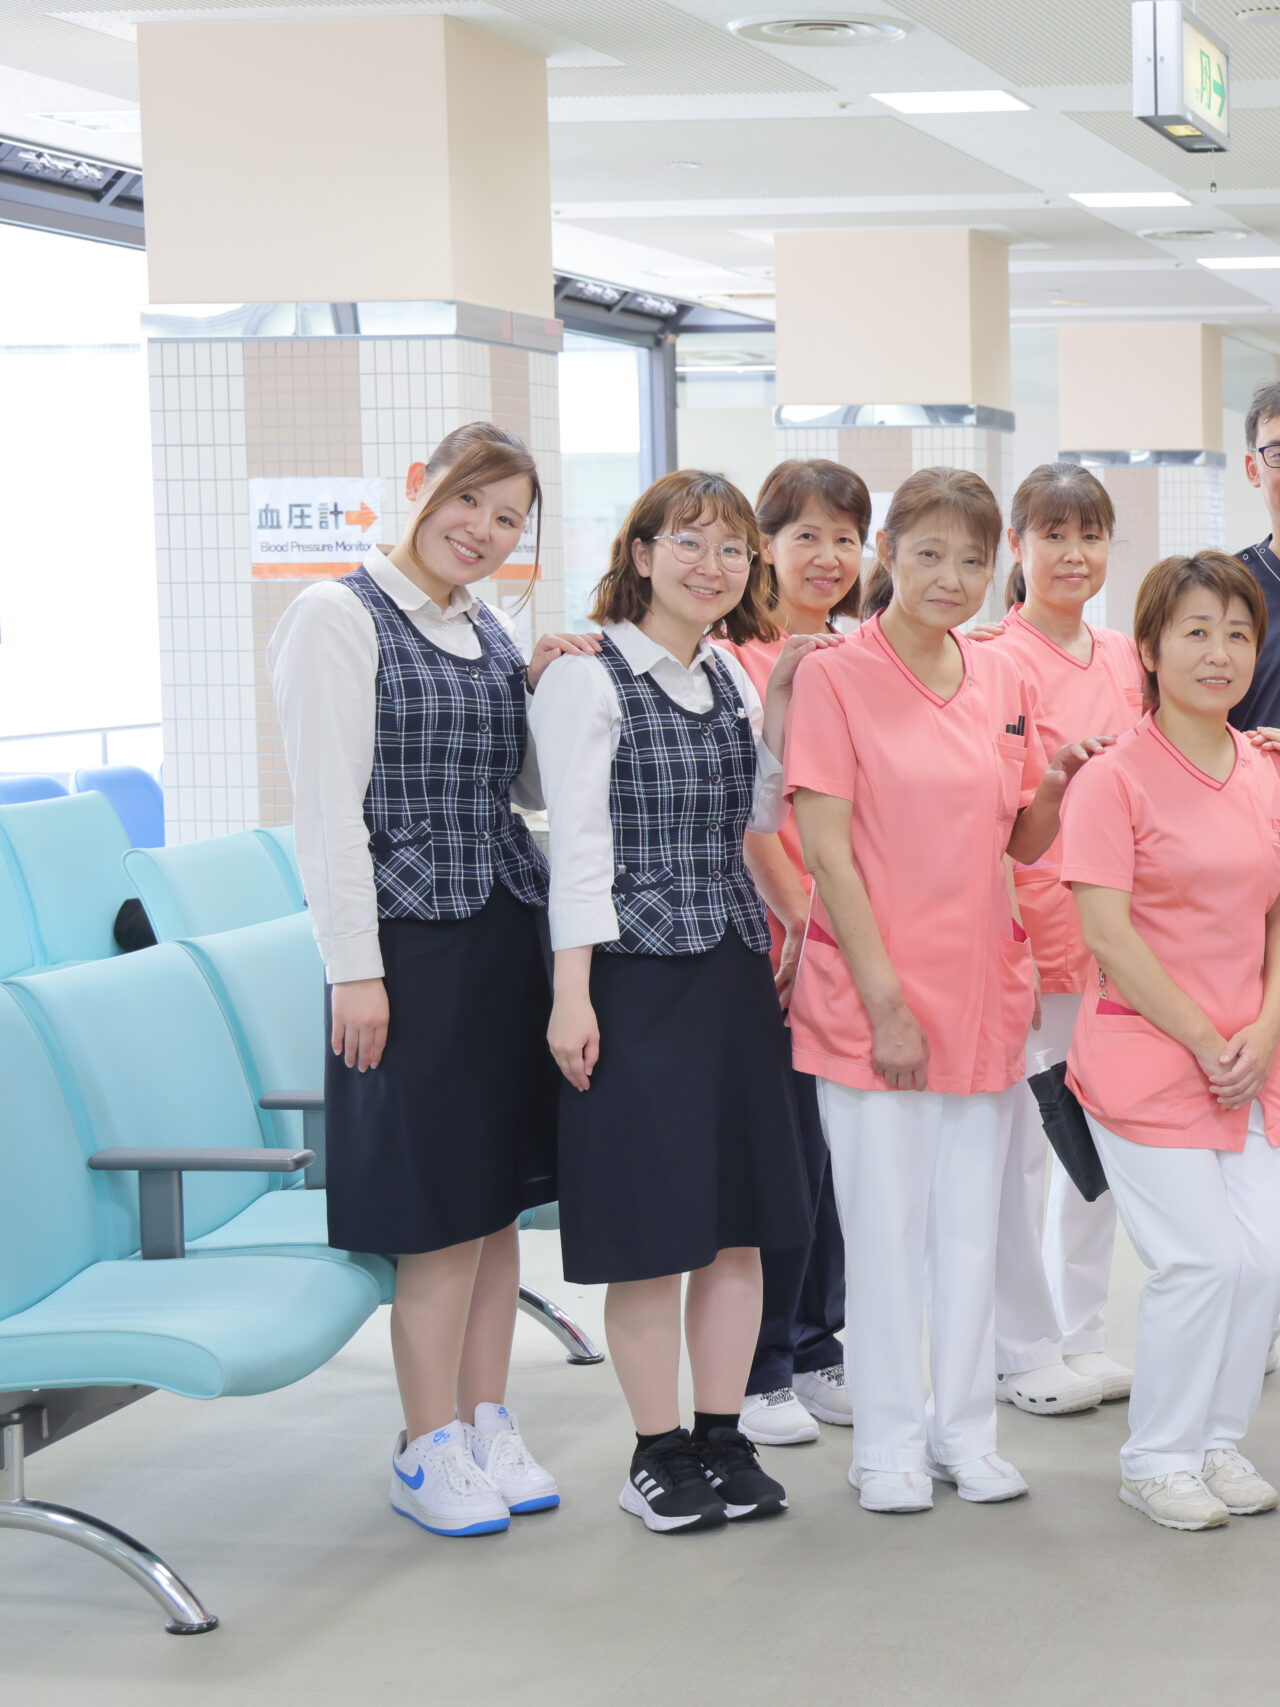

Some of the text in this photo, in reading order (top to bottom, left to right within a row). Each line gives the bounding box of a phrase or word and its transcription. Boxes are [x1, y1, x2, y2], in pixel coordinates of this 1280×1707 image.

[256, 502, 344, 530] 血圧計
[260, 540, 372, 552] Blood Pressure Monito
